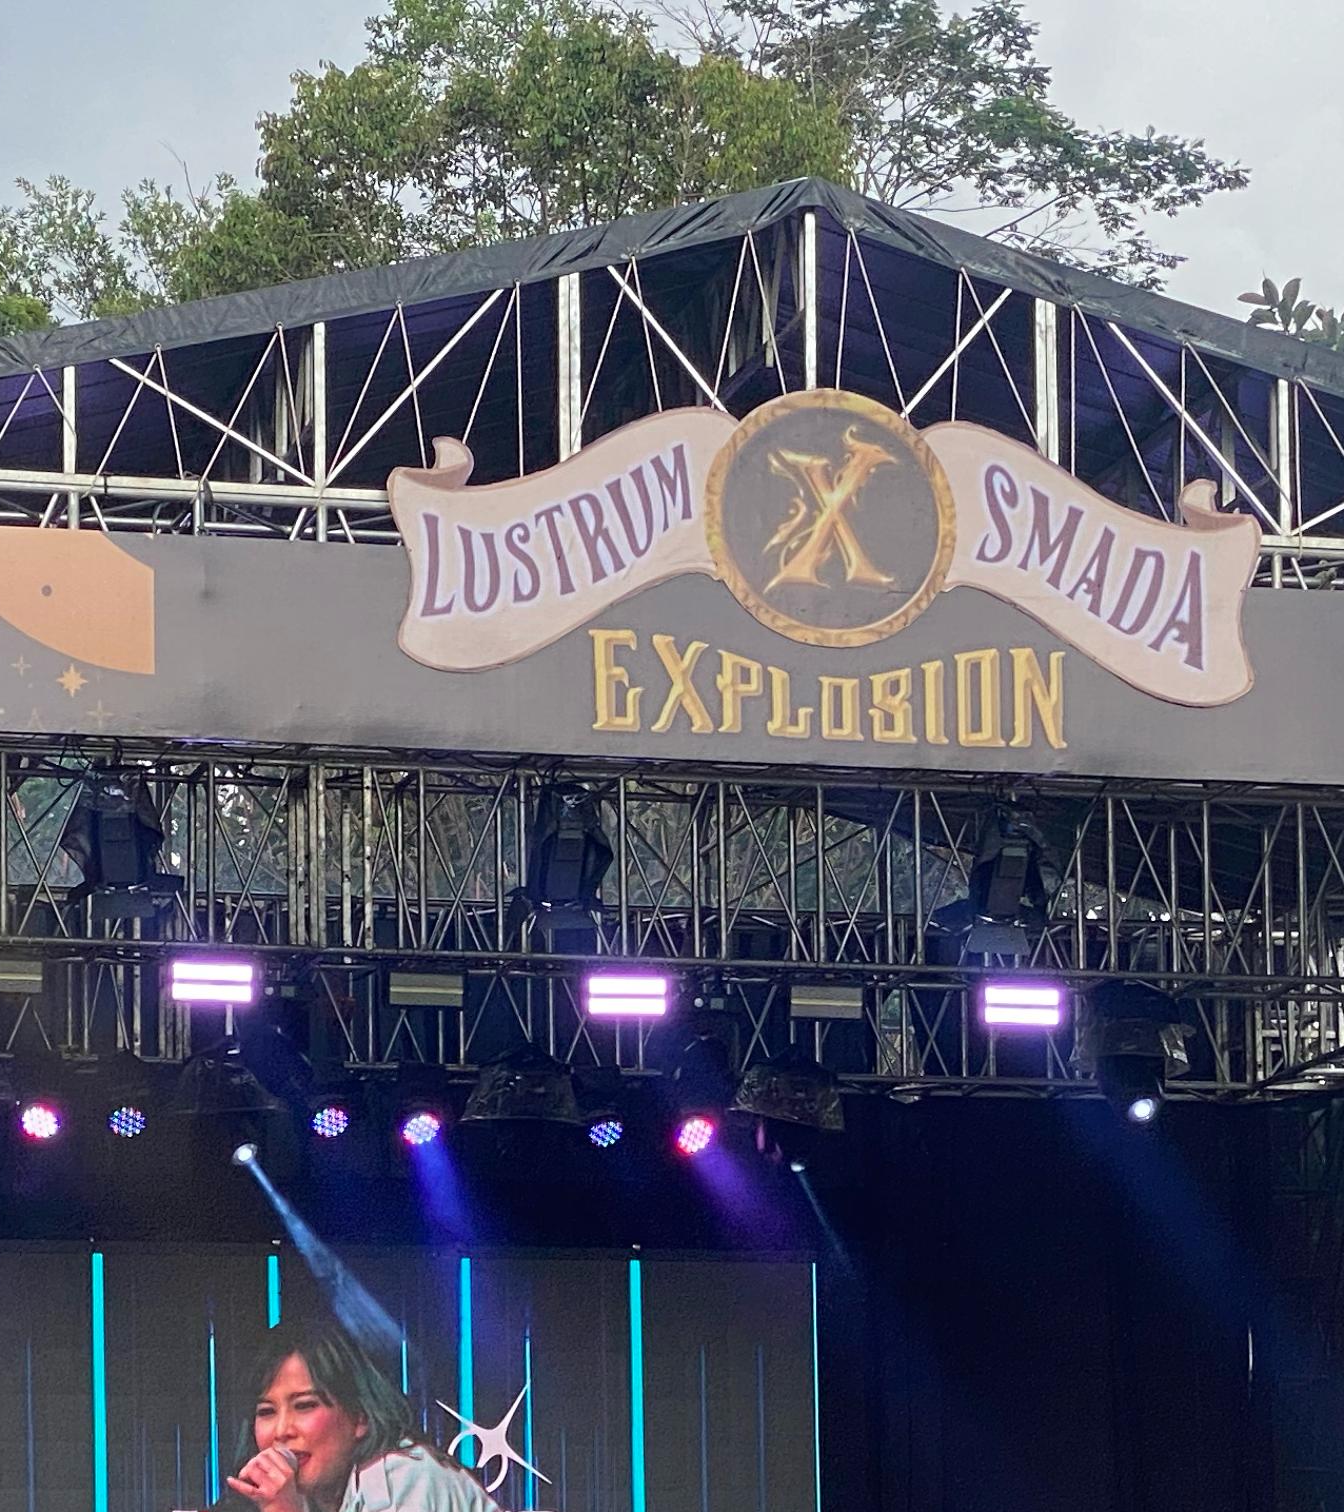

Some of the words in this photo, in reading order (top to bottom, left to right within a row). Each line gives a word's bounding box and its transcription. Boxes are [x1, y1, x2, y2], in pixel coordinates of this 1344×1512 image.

[418, 442, 694, 617] LUSTRUM
[976, 464, 1206, 672] SMADA
[588, 628, 1068, 751] EXPLOSION
